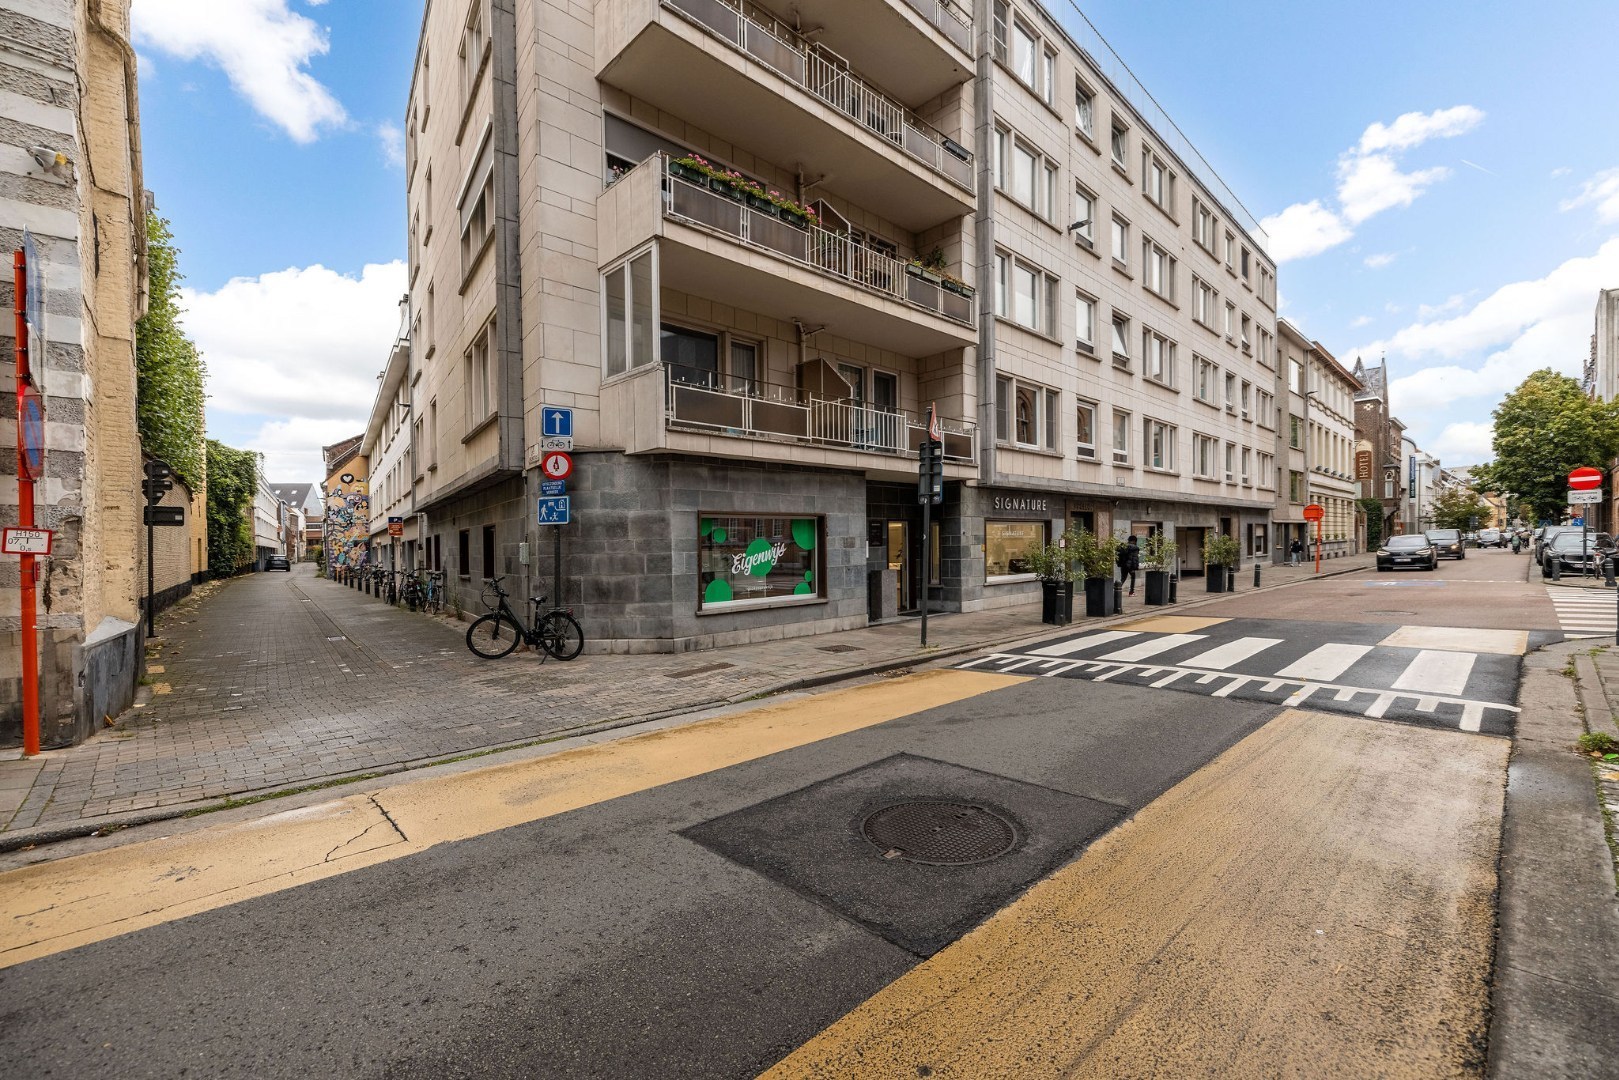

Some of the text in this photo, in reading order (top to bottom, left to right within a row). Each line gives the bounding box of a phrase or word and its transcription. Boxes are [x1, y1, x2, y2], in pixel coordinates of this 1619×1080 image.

[1359, 451, 1369, 479] HOTEL
[994, 497, 1047, 511] SIGNATURE
[15, 530, 41, 538] H150
[731, 542, 787, 576] Eigenwijs
